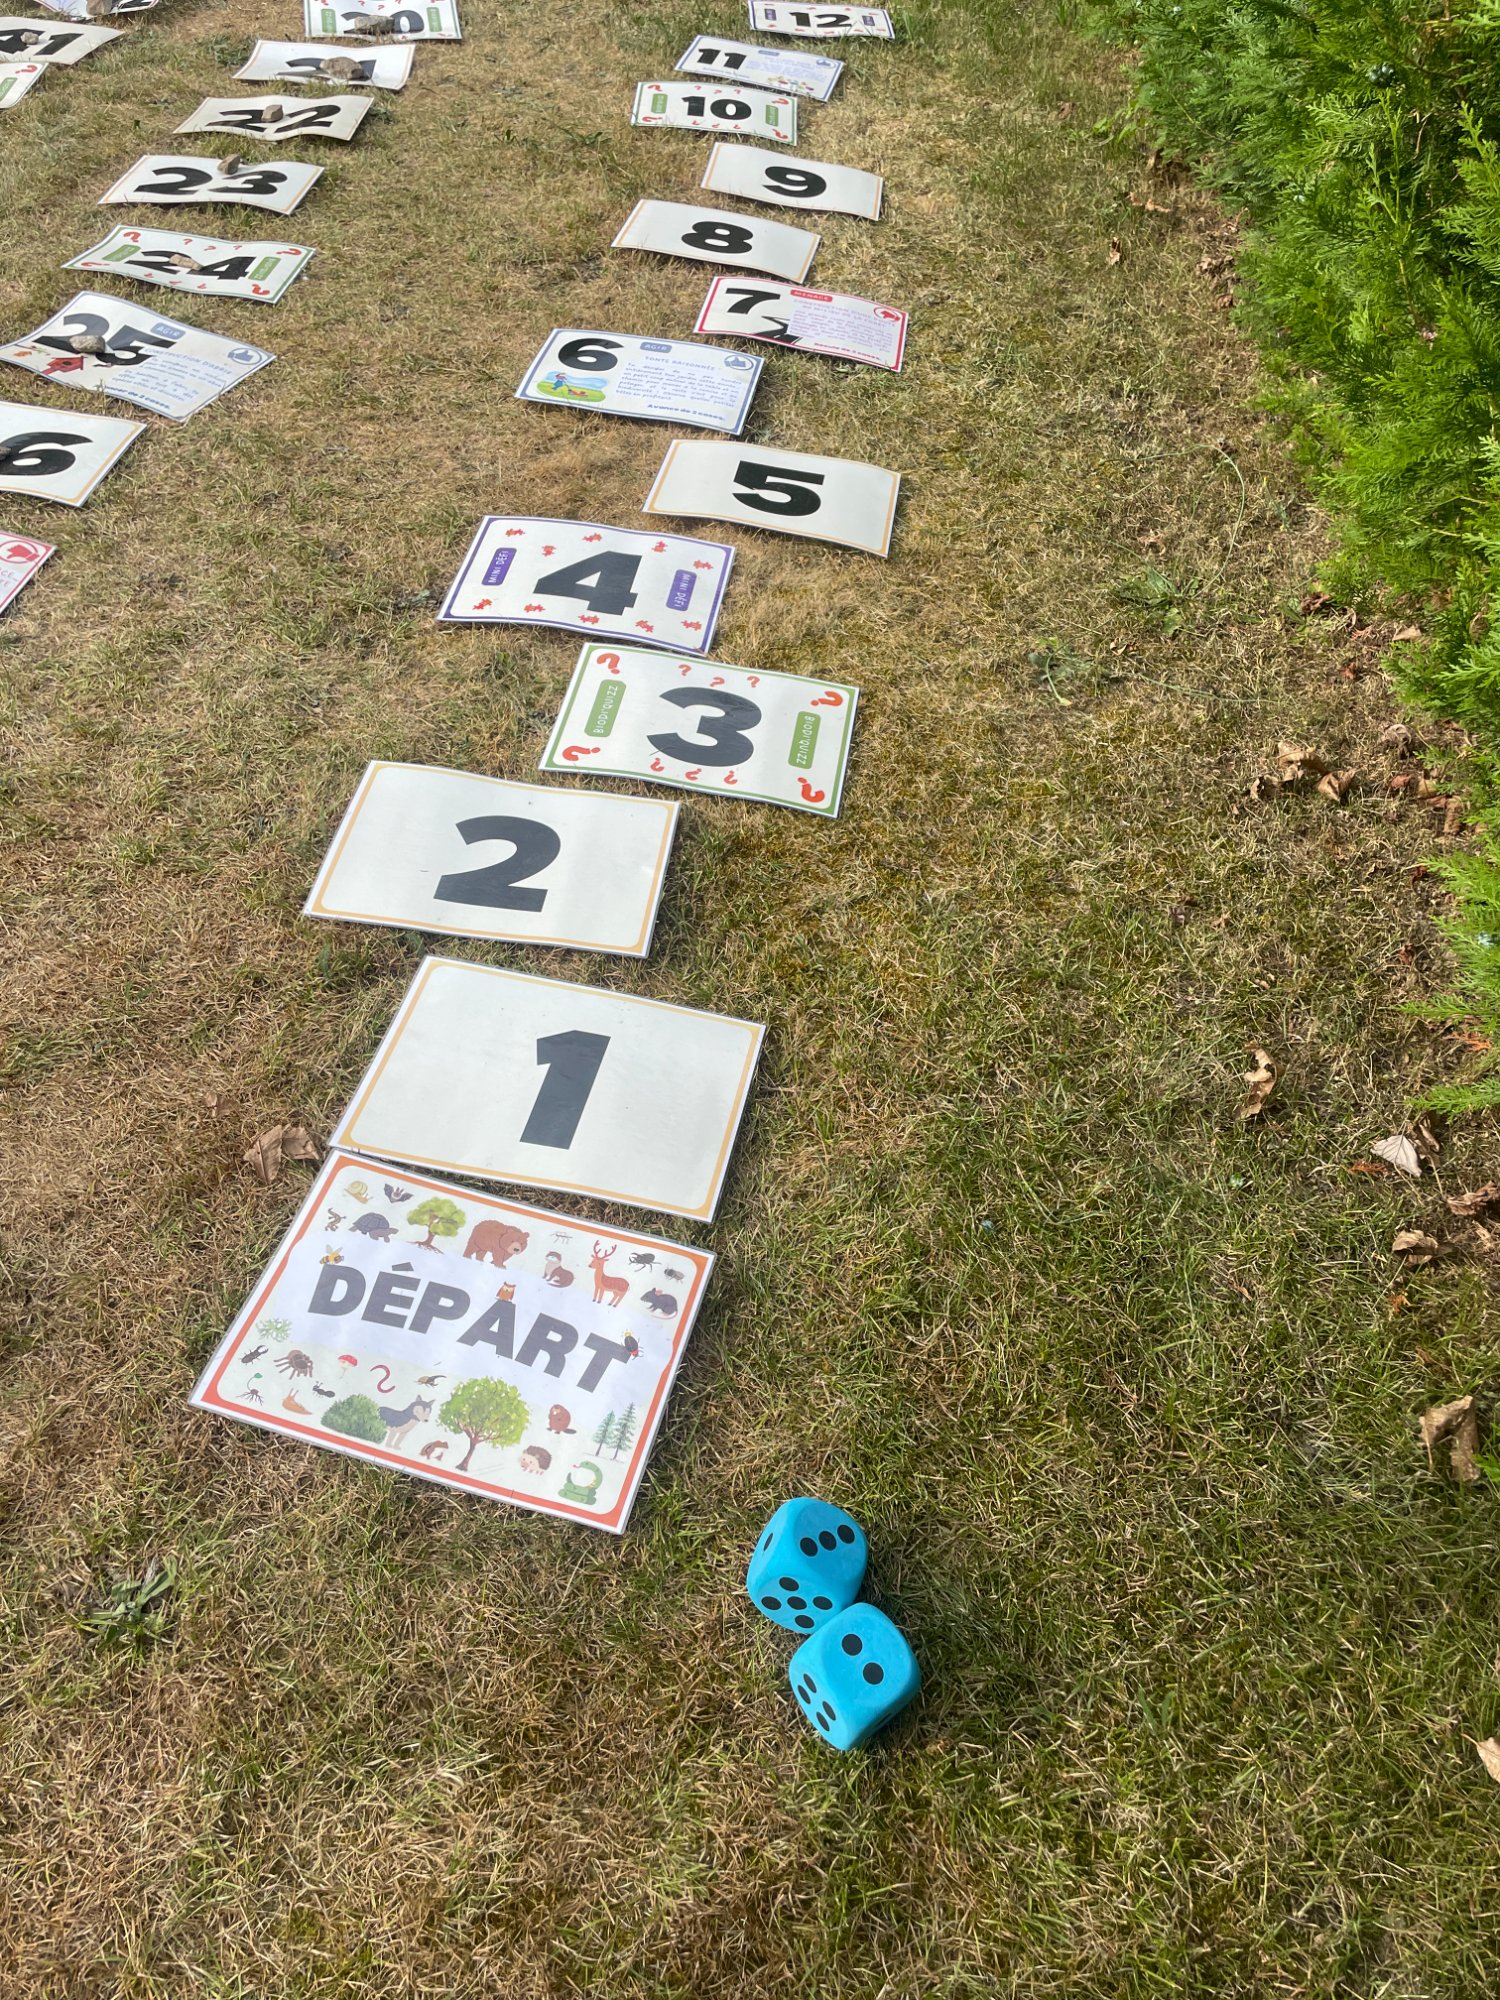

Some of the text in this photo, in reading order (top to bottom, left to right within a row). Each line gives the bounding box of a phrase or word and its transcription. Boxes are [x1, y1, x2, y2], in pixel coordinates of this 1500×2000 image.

[789, 11, 852, 27] 12
[697, 48, 747, 70] 11
[206, 104, 341, 134] 22
[682, 96, 752, 120] 10
[133, 166, 288, 196] 23
[762, 166, 827, 198] 9
[681, 221, 754, 254] 8
[124, 250, 257, 281] 24
[724, 287, 781, 315] 7
[32, 313, 177, 365] 25
[558, 338, 624, 371] 6
[732, 460, 825, 516] 5
[533, 550, 642, 616] 4
[646, 687, 762, 767] 3
[434, 815, 561, 912] 2
[520, 1029, 611, 1150] 1
[308, 1262, 629, 1392] DÉPART
